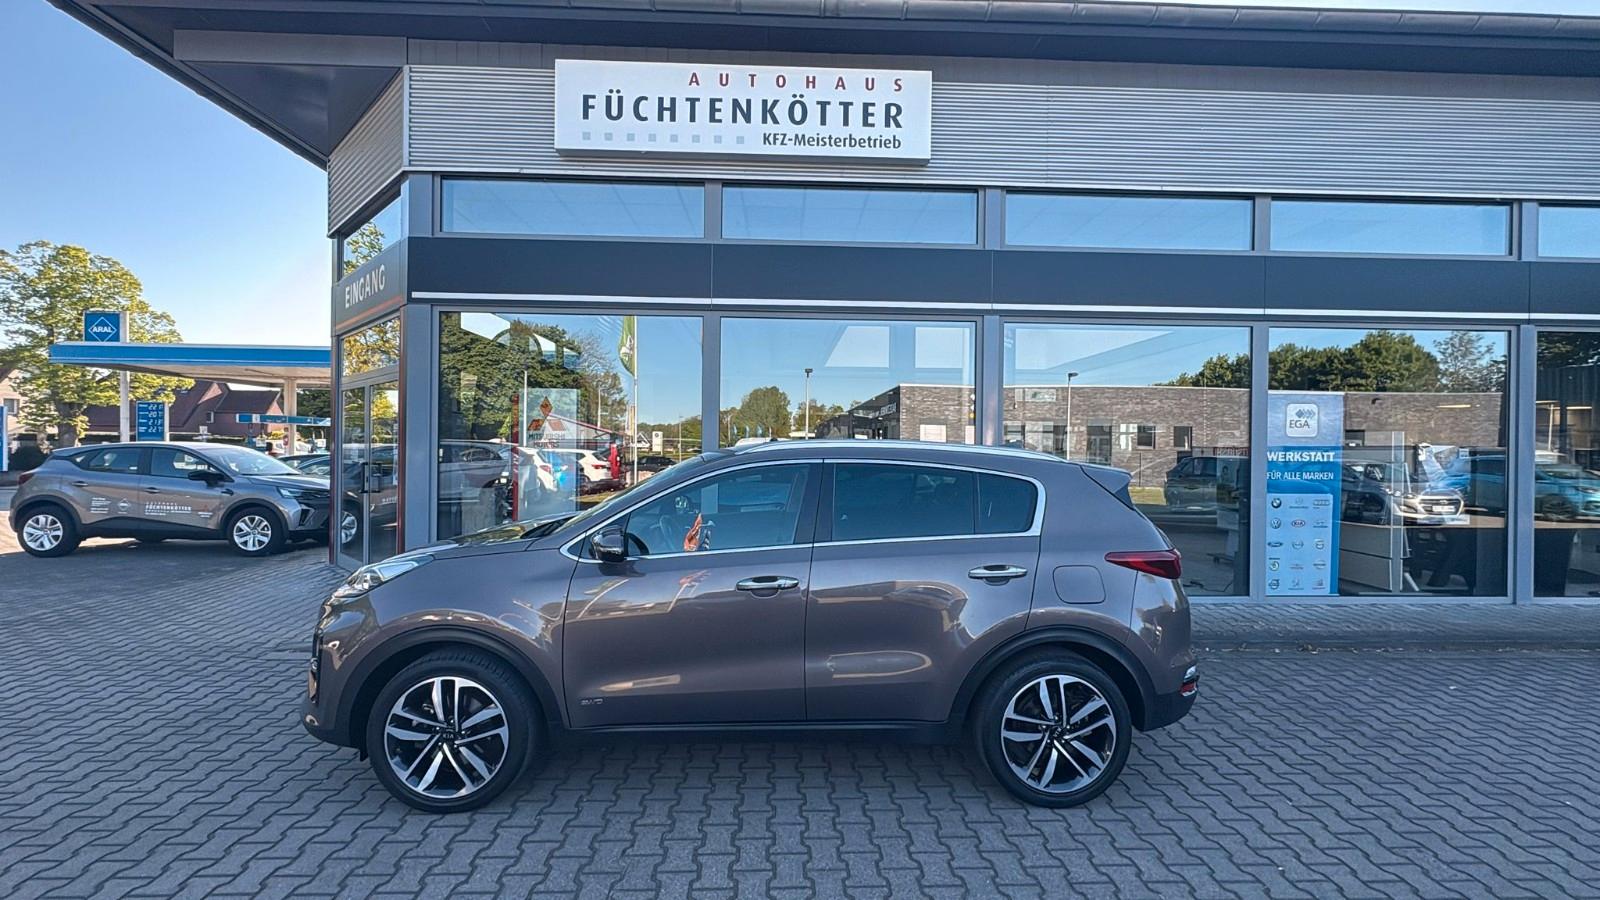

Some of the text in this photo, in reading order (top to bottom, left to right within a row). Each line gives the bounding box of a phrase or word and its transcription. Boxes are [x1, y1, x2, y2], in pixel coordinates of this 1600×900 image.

[688, 71, 903, 93] AUTOHAUS
[582, 88, 903, 129] FÜCHTENKÖTTER
[762, 132, 902, 149] KFZ-Meisterbetrieb
[345, 263, 386, 309] EINGANG
[1289, 419, 1311, 429] EGA
[1267, 451, 1336, 462] WERKSTATT
[1267, 469, 1334, 480] FÜR ALLE MARKEN
